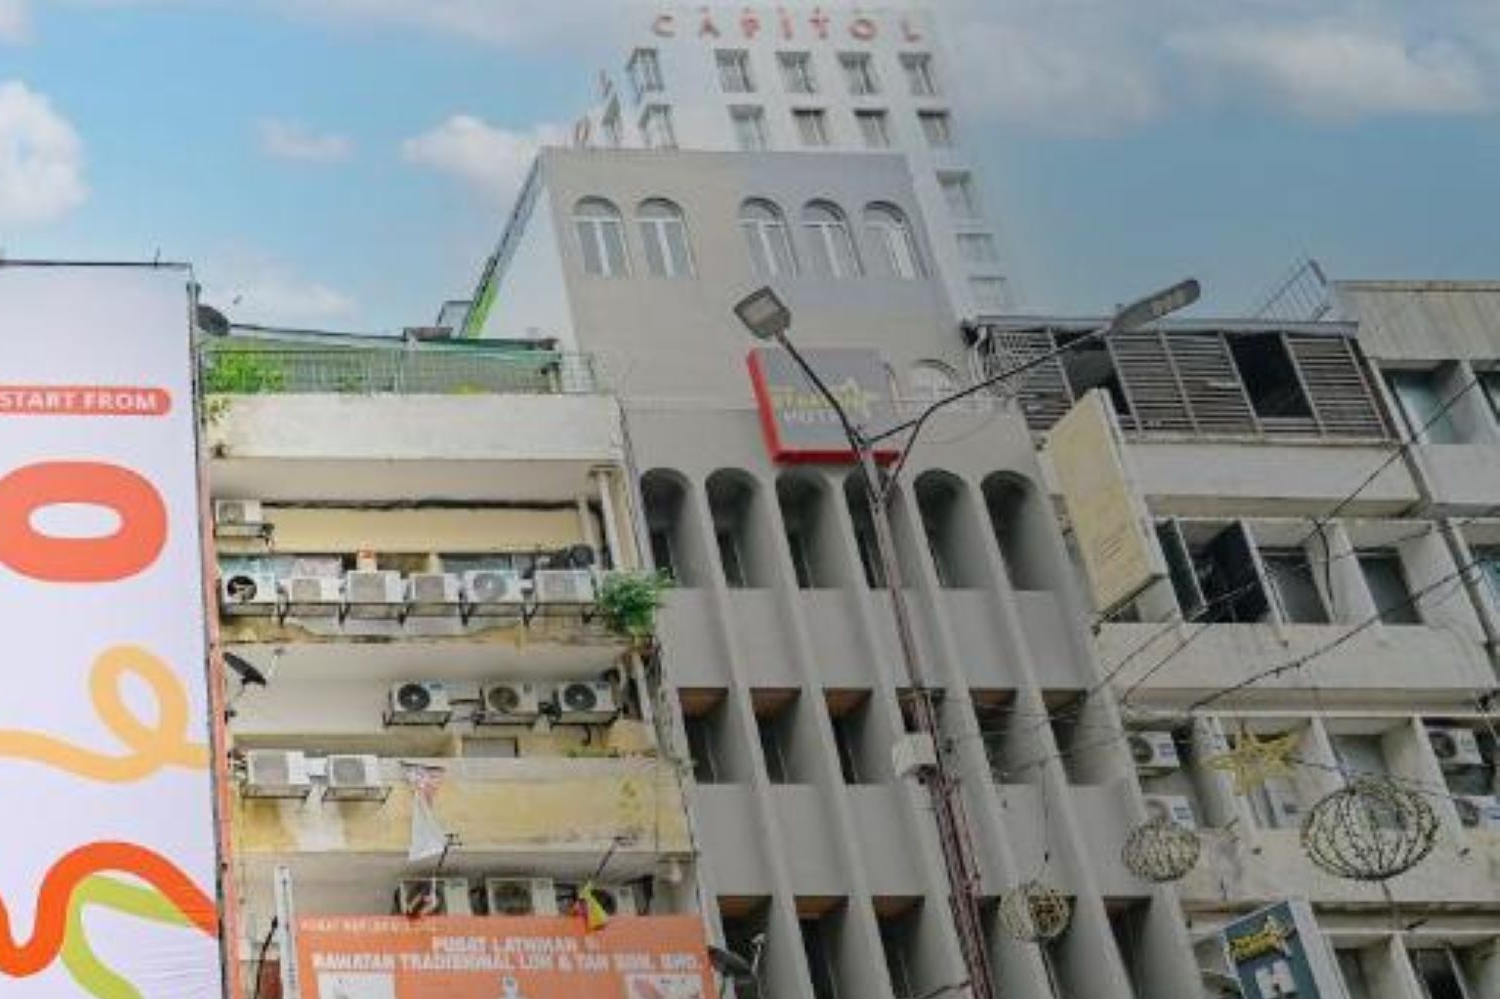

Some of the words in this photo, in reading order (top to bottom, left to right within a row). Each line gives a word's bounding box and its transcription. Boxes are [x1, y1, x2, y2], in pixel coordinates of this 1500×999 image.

[653, 9, 920, 41] CAPITOL
[0, 391, 76, 409] START
[84, 391, 157, 410] FROM
